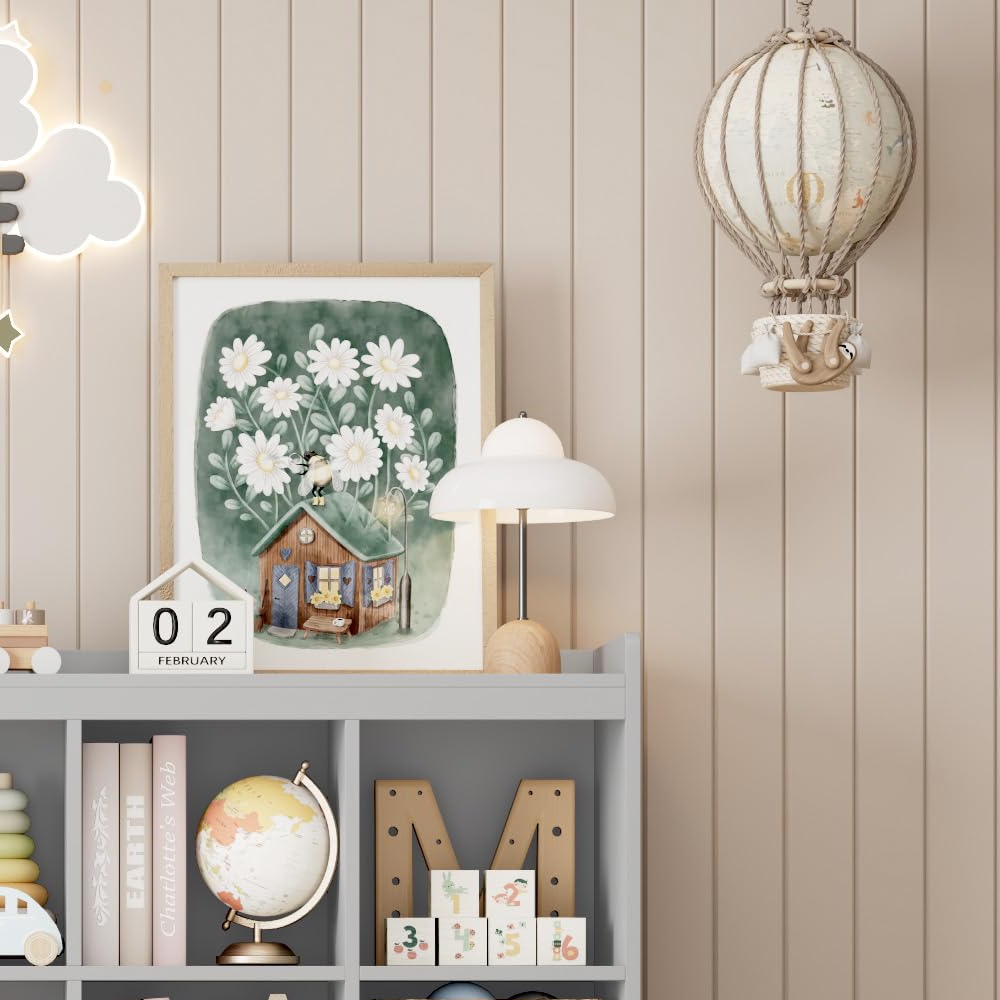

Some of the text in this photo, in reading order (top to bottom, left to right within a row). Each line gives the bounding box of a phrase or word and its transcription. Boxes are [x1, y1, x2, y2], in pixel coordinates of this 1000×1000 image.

[158, 656, 226, 666] FEBRUARY
[160, 760, 176, 808] Web
[126, 795, 145, 909] EARTH
[403, 925, 418, 948] 3
[505, 933, 521, 957] 5
[562, 935, 579, 961] 6
